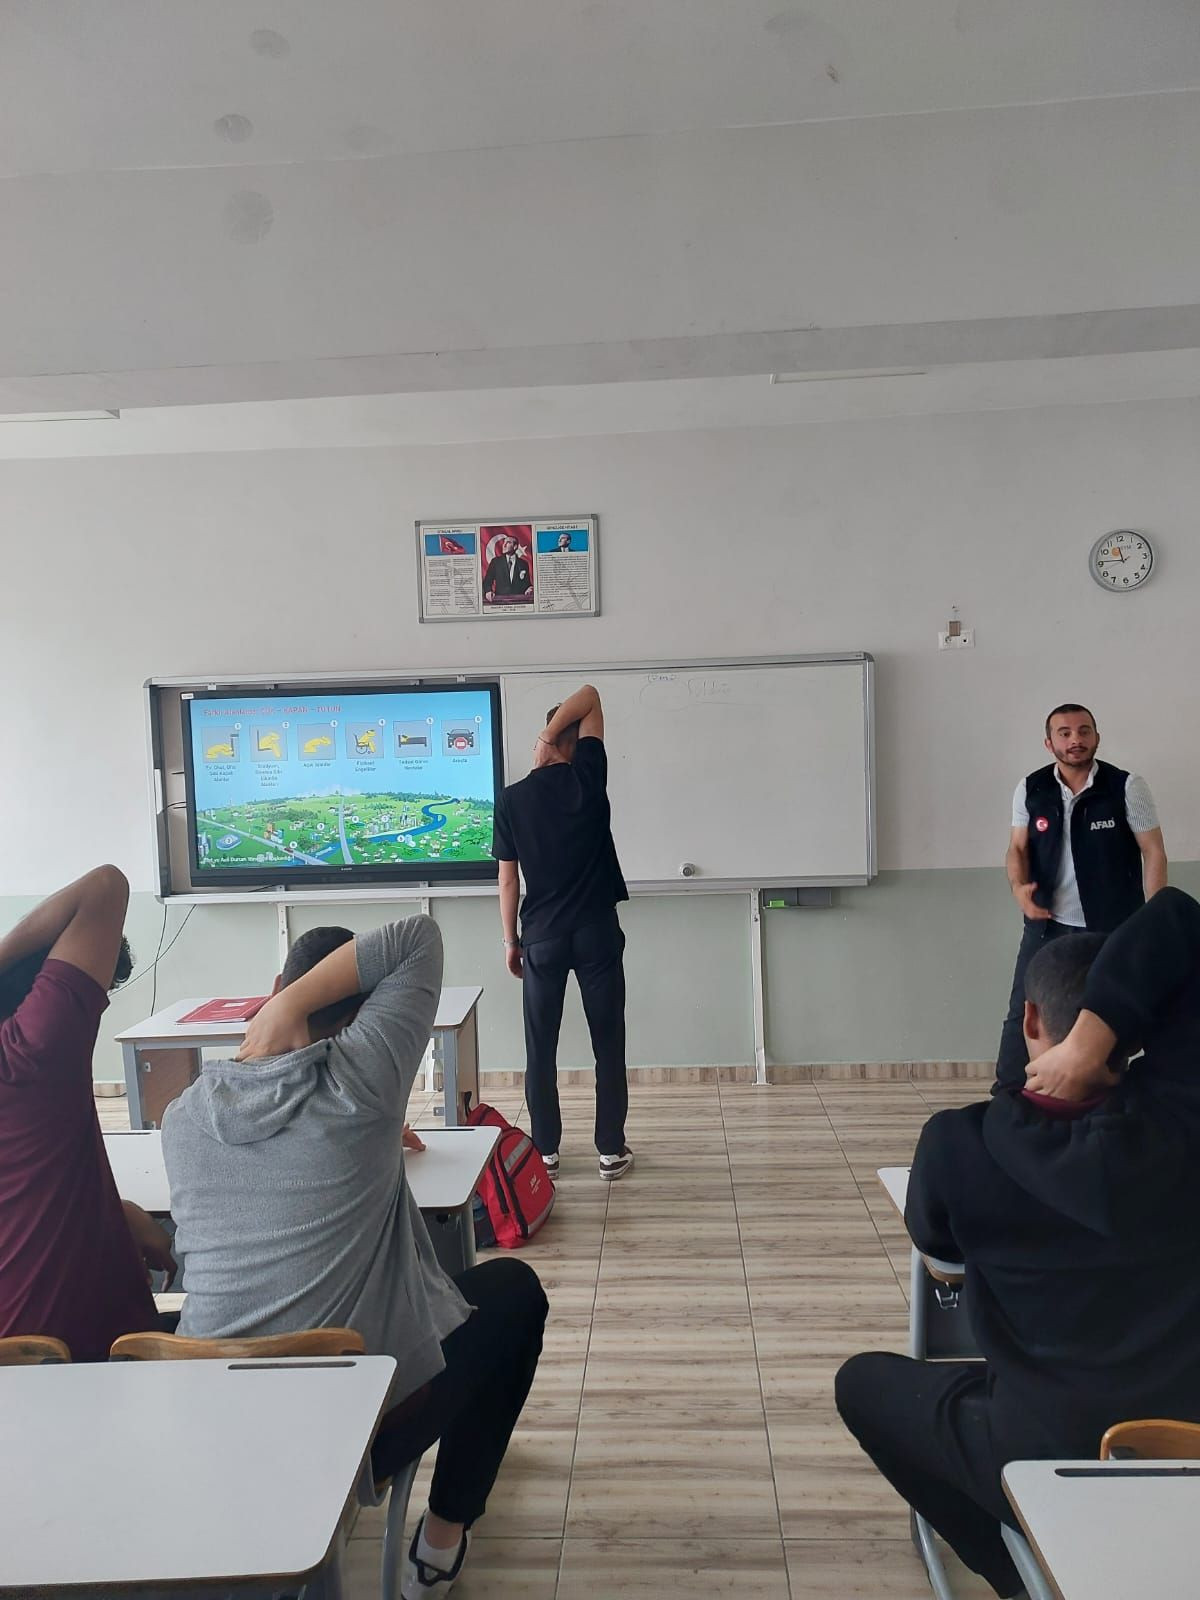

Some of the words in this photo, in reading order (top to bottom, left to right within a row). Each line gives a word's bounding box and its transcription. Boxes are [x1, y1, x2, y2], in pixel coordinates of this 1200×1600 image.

[1116, 535, 1124, 543] 12
[1100, 548, 1109, 556] 10
[1142, 552, 1148, 560] 3
[1097, 560, 1104, 568] 9
[1102, 570, 1109, 578] 8
[1090, 818, 1116, 831] AFAD
